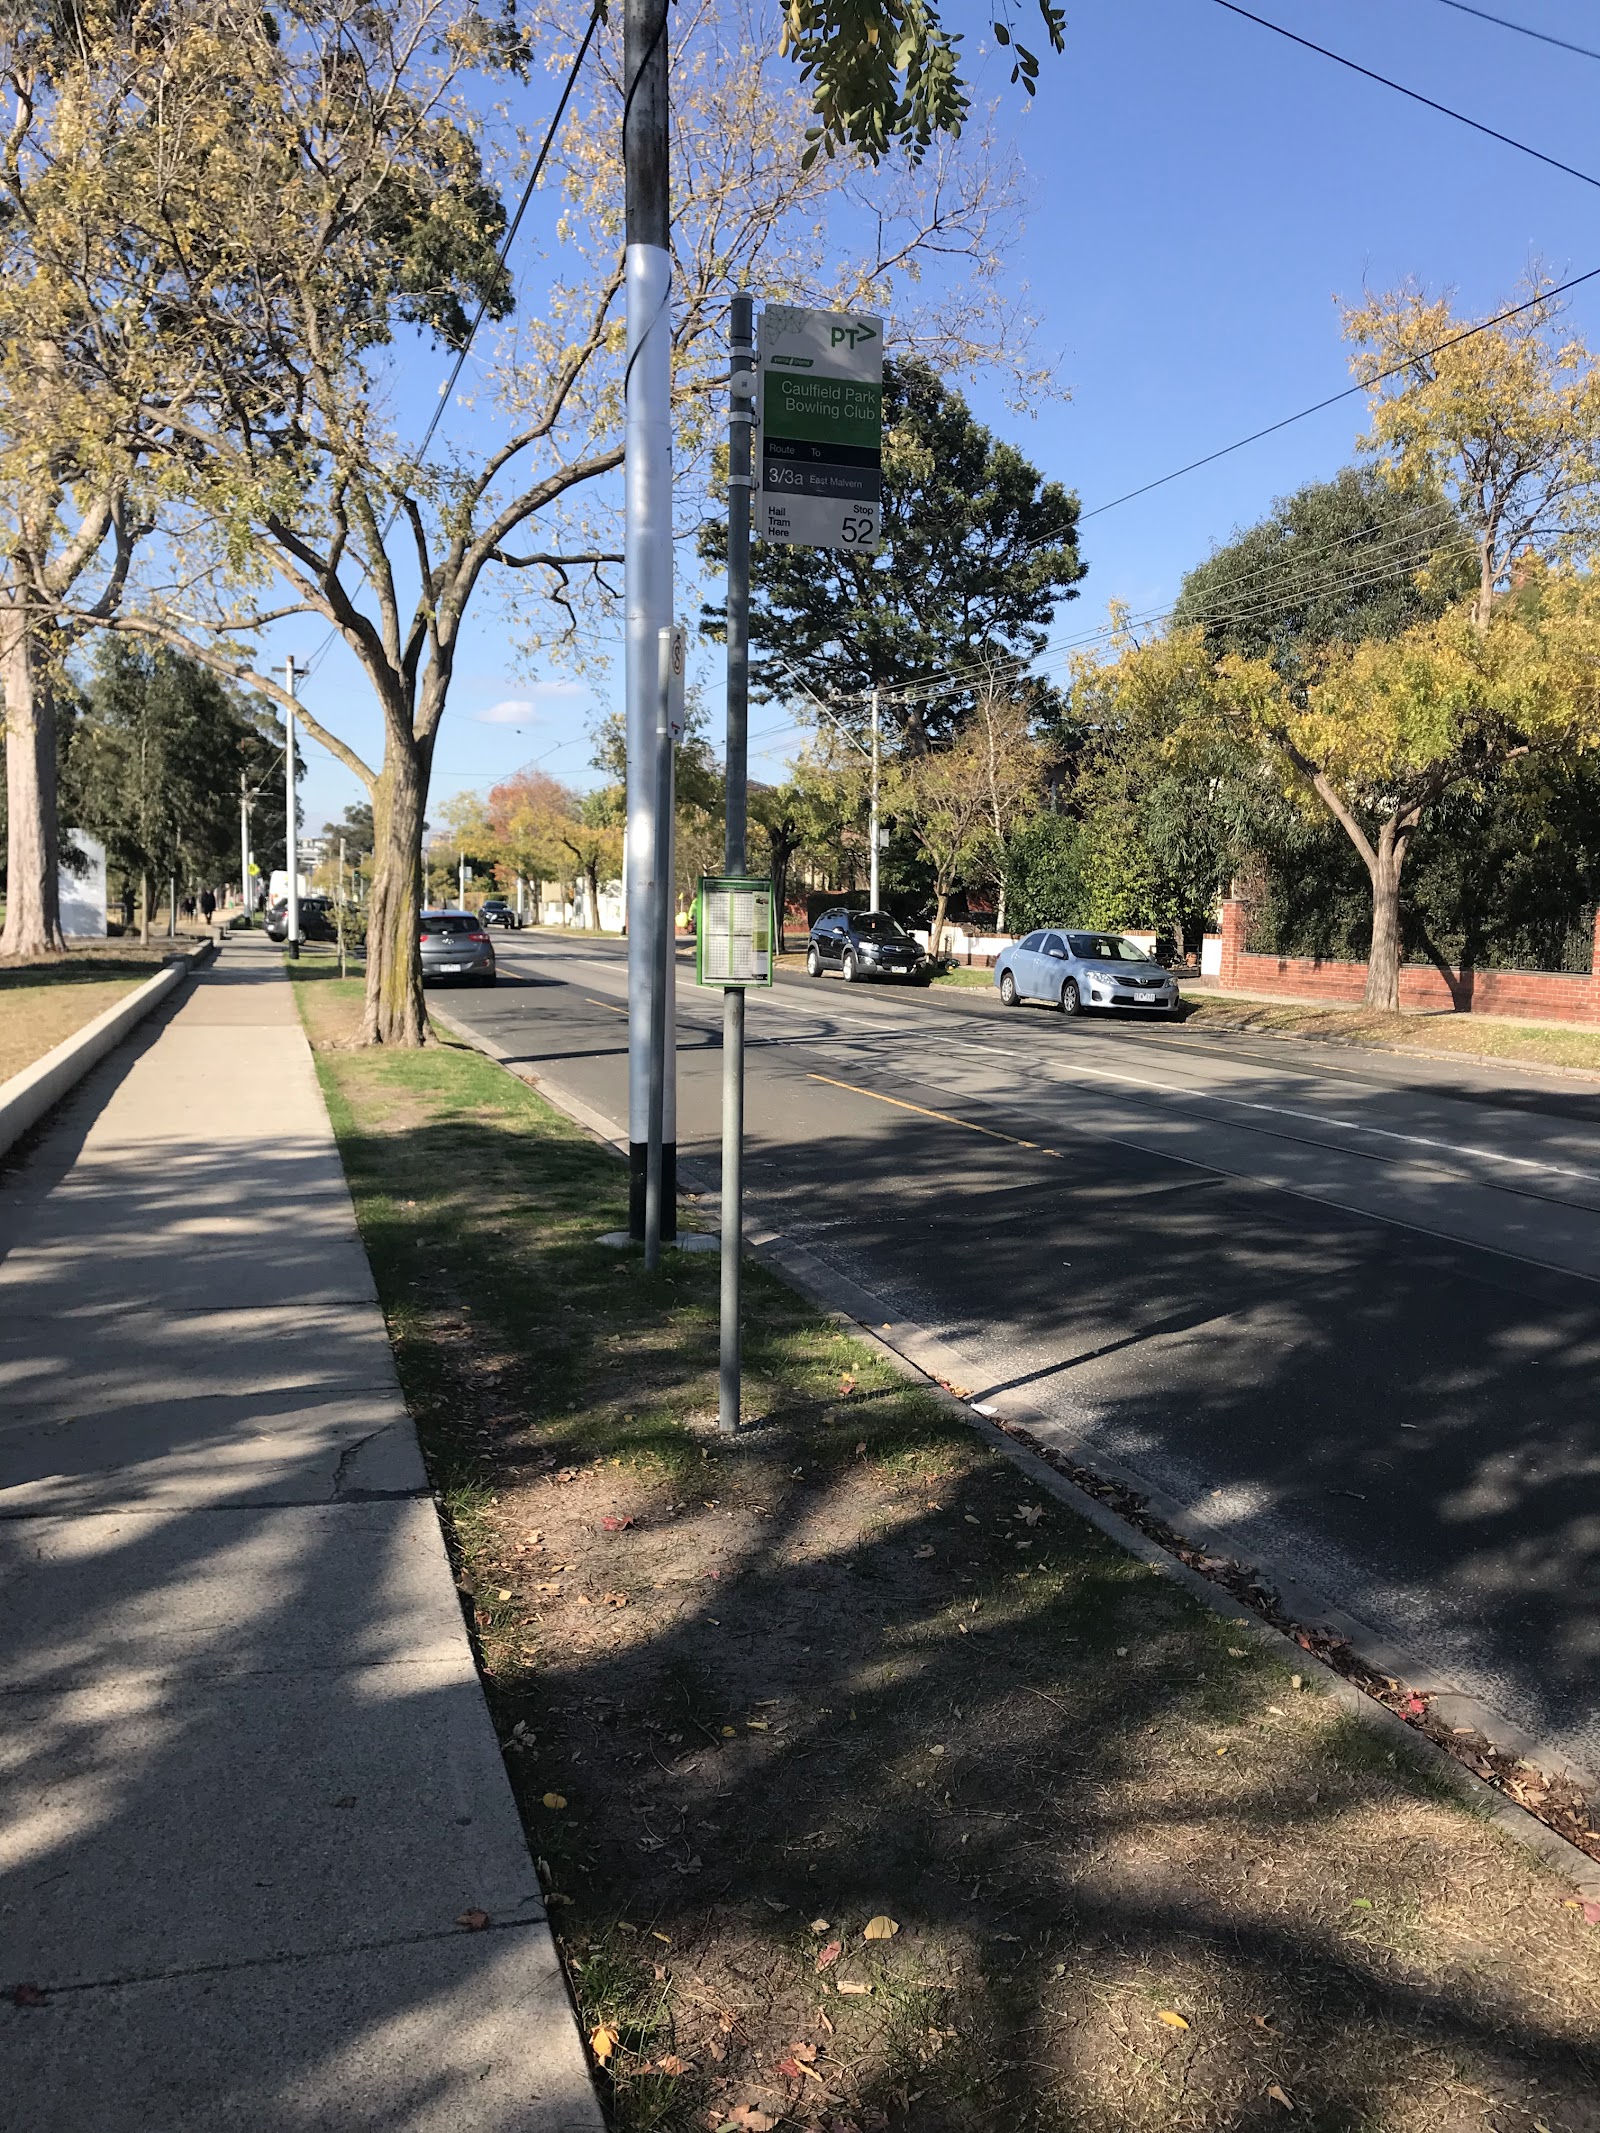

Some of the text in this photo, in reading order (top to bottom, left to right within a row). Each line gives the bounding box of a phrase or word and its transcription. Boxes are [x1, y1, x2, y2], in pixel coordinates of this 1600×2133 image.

[781, 381, 876, 404] Caulfield Park
[785, 397, 875, 420] Bowling Club
[769, 443, 821, 457] Route To
[769, 467, 863, 489] 3/3a East Malvern
[768, 506, 786, 516] Hail
[853, 504, 874, 516] Stop
[768, 517, 790, 527] Tram
[768, 527, 789, 537] Here
[841, 517, 874, 544] 52
